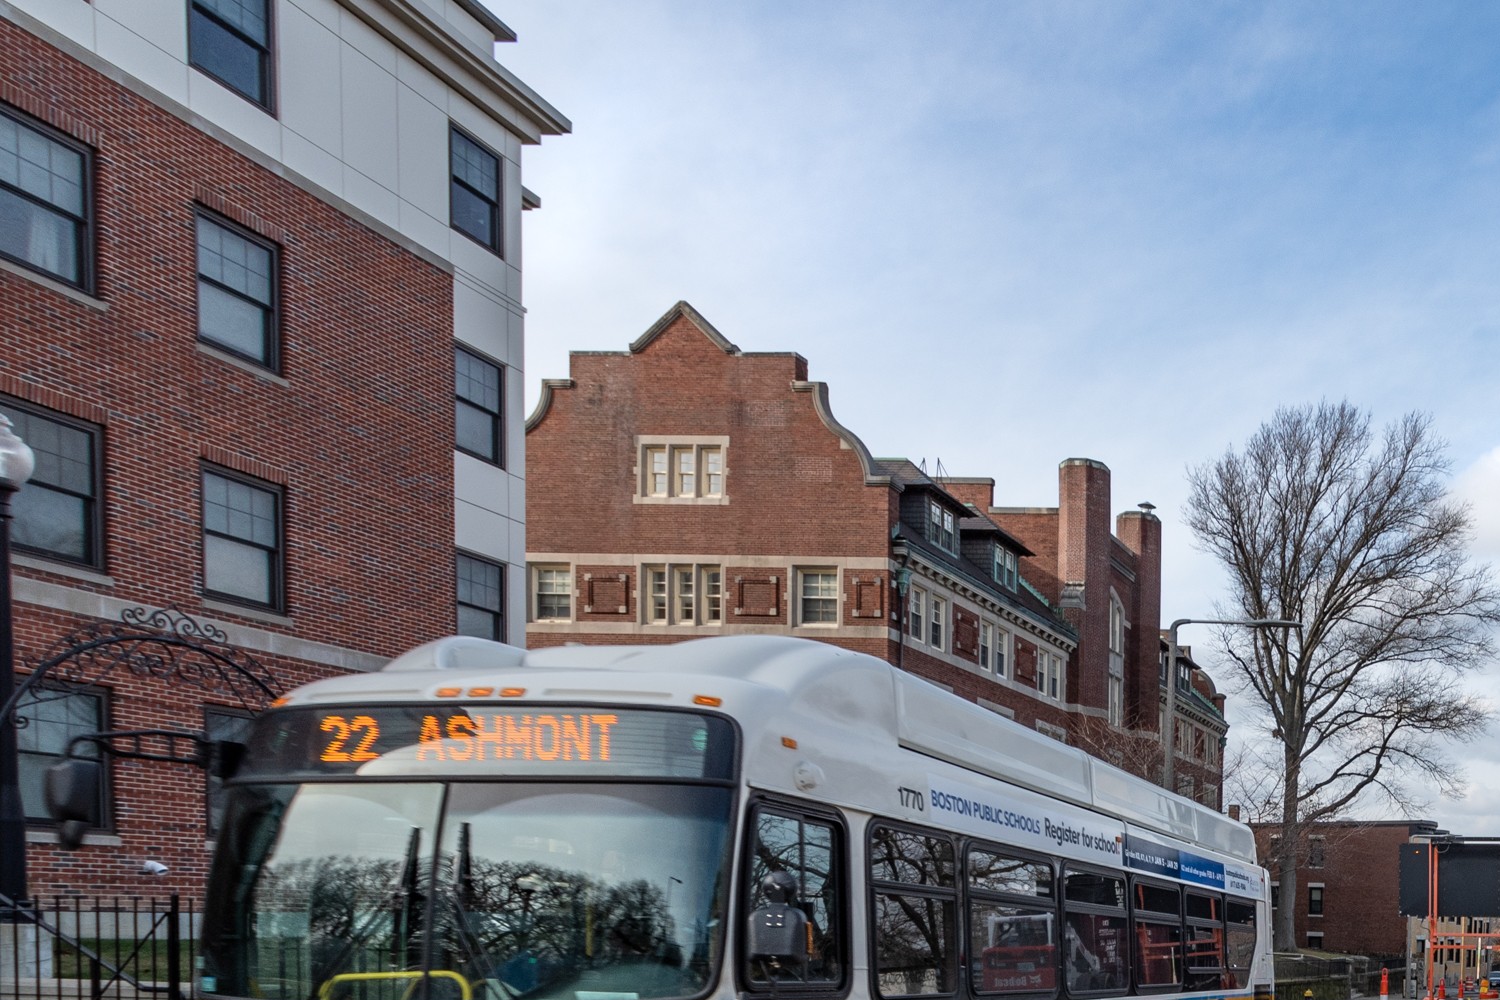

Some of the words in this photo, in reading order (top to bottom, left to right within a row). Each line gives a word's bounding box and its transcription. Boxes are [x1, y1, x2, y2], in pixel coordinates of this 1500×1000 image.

[320, 715, 381, 762] 22
[416, 714, 619, 762] ASHMONT
[898, 787, 924, 812] 1770
[931, 790, 972, 816] BOSTON
[973, 807, 1004, 825] PUBLIC
[1004, 811, 1040, 834] SCHOOLS
[1044, 817, 1081, 846] Register
[1082, 827, 1094, 849] for
